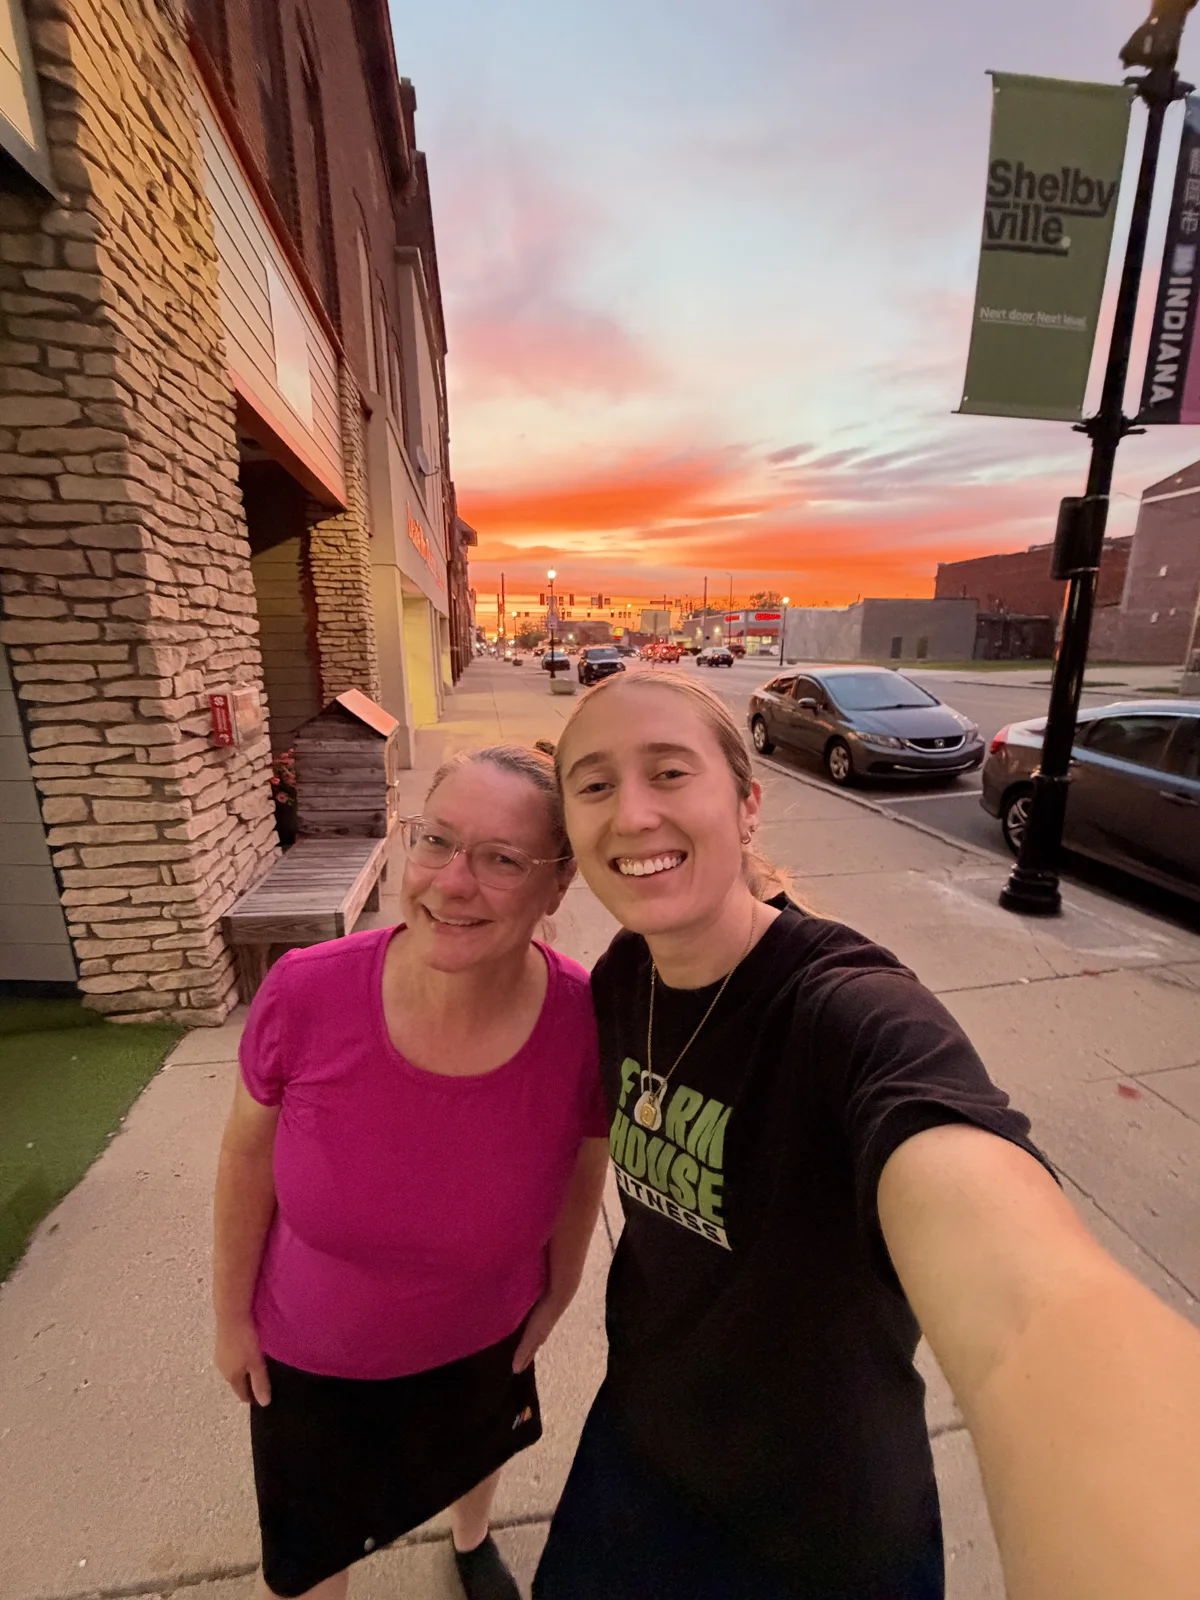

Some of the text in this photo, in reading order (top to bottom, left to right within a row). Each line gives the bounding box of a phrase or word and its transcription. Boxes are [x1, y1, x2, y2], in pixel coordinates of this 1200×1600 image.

[987, 158, 1118, 217] Shelby
[1150, 278, 1192, 404] INDIANA
[609, 1108, 725, 1227] HOUSE
[613, 1164, 724, 1244] FITNESS
